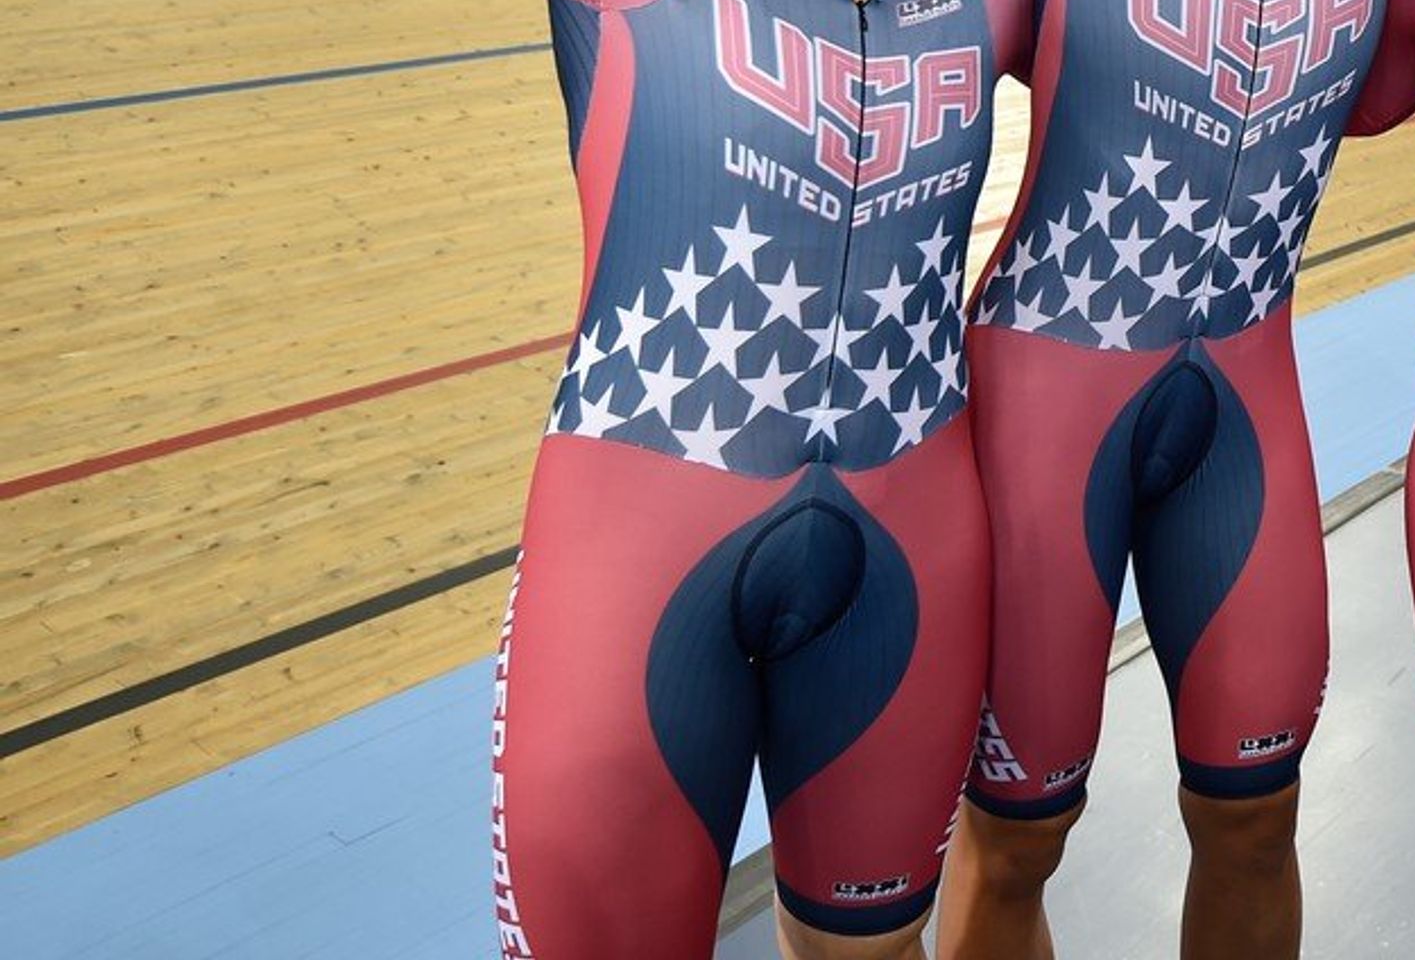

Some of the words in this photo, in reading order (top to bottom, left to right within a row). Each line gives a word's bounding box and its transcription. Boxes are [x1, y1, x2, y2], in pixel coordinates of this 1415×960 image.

[1133, 80, 1231, 148] UNITED
[1241, 67, 1357, 151] STATES
[724, 137, 842, 222] UNITED
[851, 161, 973, 228] STATES
